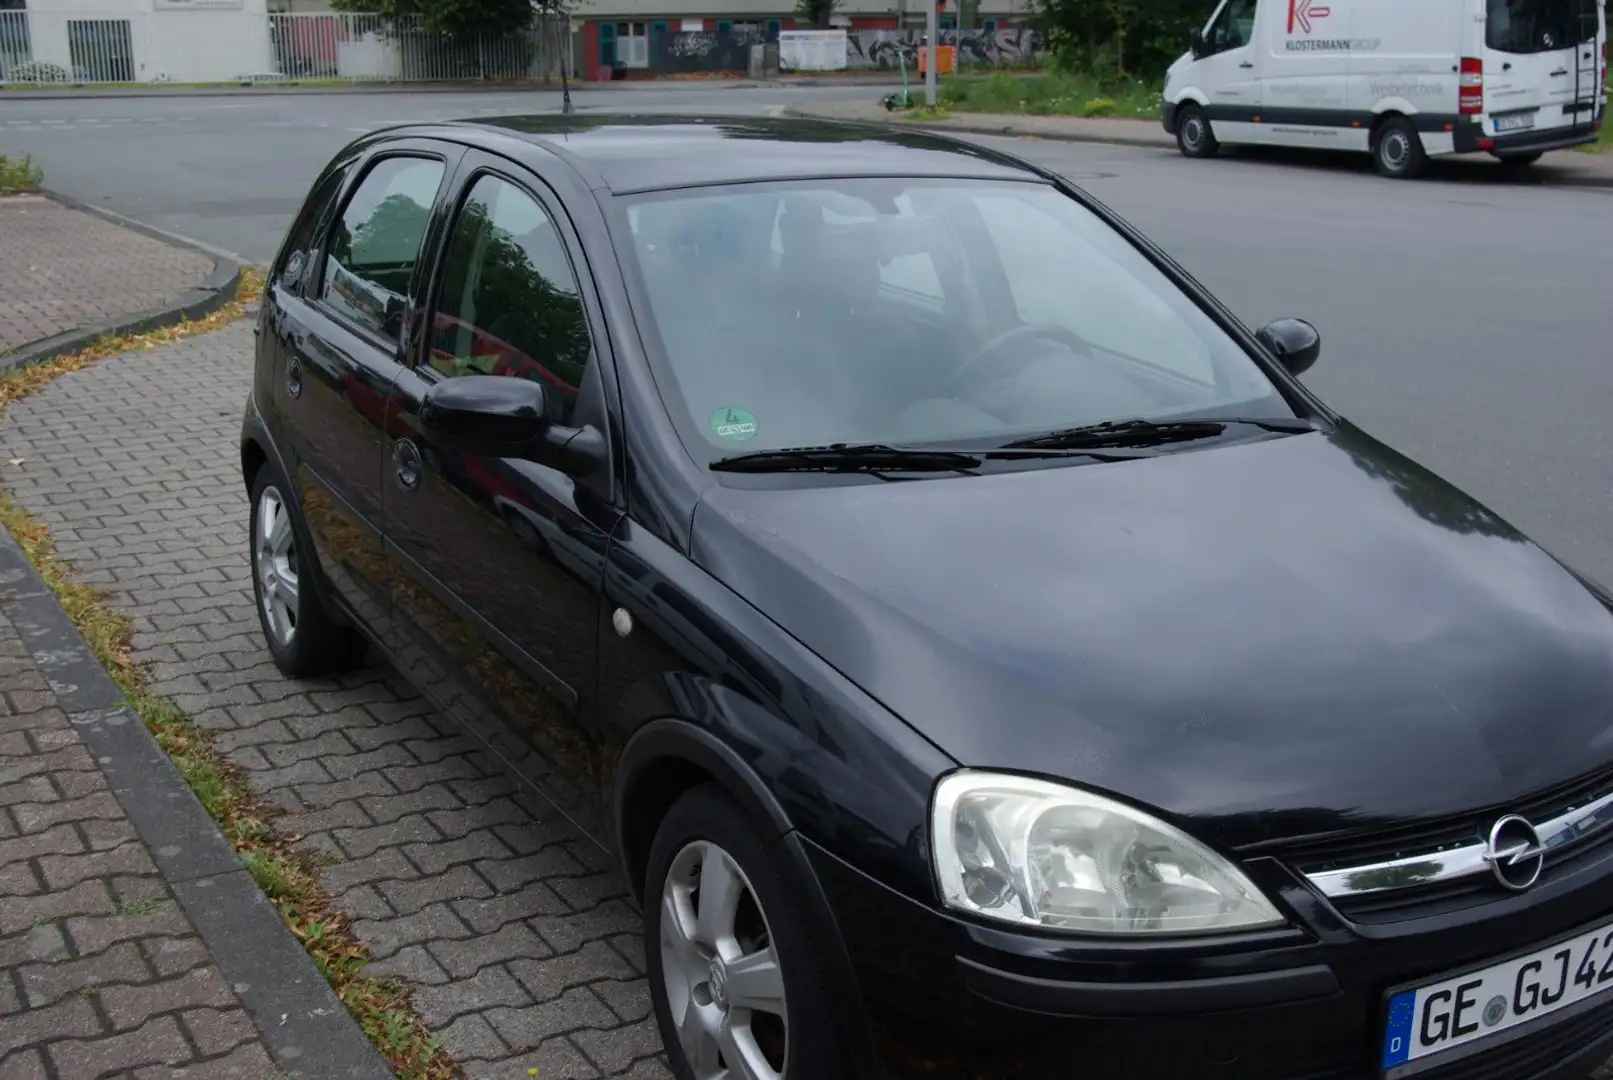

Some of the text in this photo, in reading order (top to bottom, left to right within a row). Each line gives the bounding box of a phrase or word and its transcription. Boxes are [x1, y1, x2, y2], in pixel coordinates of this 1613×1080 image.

[726, 408, 740, 424] 4
[1420, 979, 1483, 1046] GE
[1390, 1036, 1401, 1053] D
